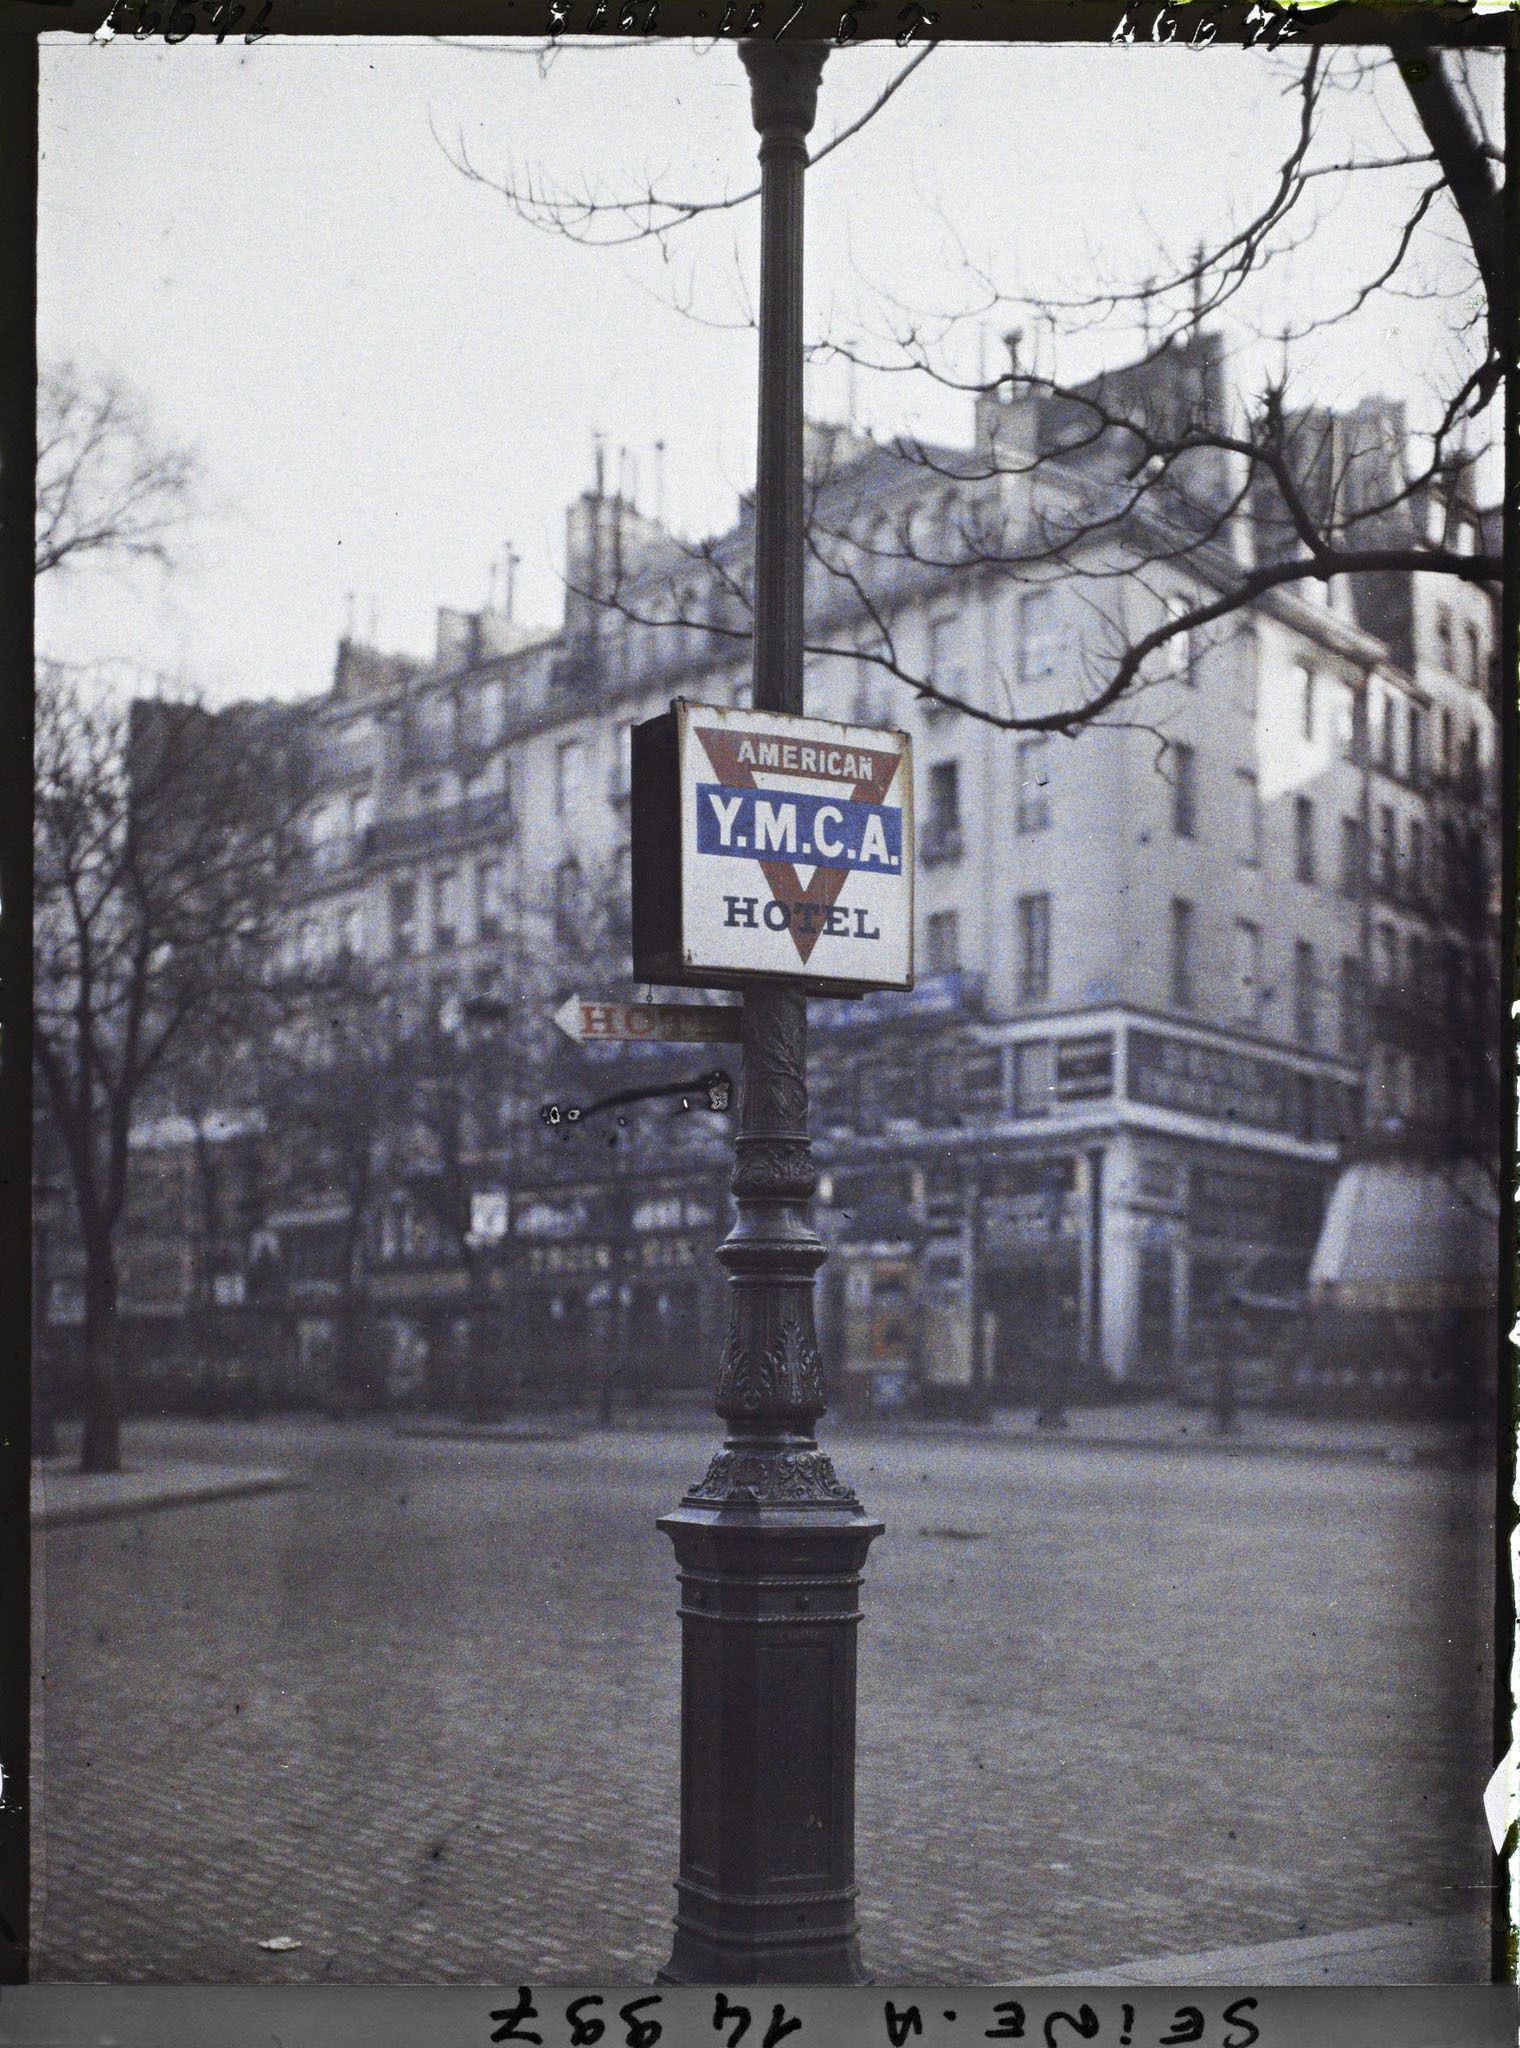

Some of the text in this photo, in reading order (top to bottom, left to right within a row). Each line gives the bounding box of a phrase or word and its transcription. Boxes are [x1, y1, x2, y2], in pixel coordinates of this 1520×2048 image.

[737, 740, 873, 781] AMERICAN
[708, 794, 899, 866] Y.M.C.A.
[723, 896, 880, 940] HOTEL
